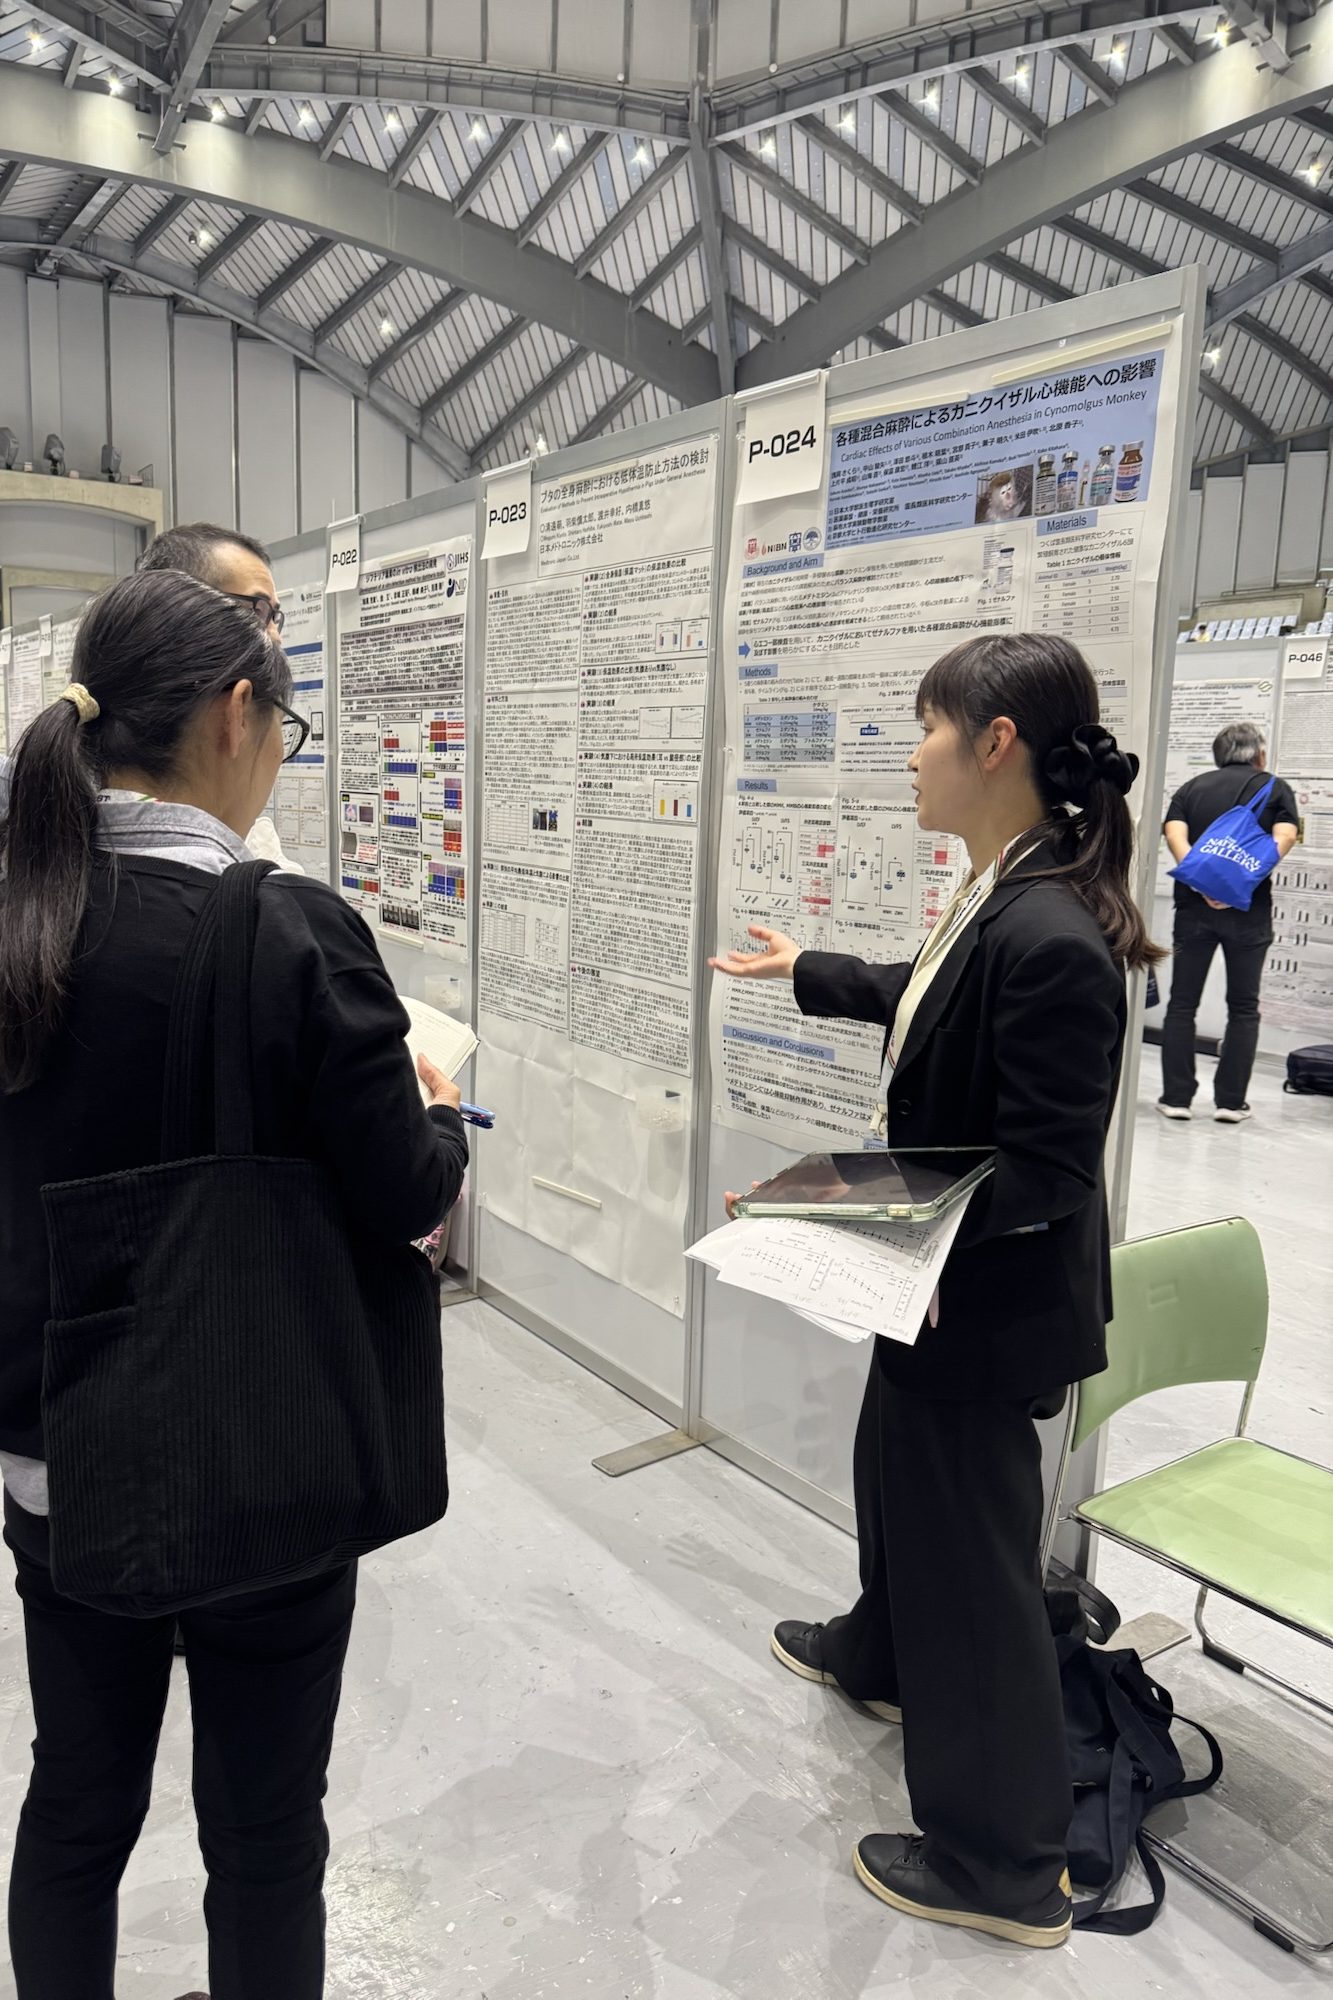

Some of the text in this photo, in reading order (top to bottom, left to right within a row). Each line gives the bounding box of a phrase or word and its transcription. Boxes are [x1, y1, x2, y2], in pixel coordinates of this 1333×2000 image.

[836, 358, 1157, 447] 各種混合麻酔によるカニクイザル心機能への影響
[841, 389, 1147, 462] Cardiac Effects of Various Combination Anesthesia in Cynomolgus Monkey
[749, 425, 816, 464] P-024
[541, 448, 709, 503] ブタの全身麻酔における低体温防止方法の検討
[489, 502, 527, 527] P-023
[1046, 516, 1087, 532] Materials
[332, 549, 357, 568] P-022
[454, 552, 469, 567] JIHS
[747, 557, 818, 576] Background and Aim
[1288, 652, 1323, 663] P-046
[745, 668, 771, 677] Methods
[744, 781, 769, 790] Results
[1200, 844, 1260, 872] GALLERY
[1206, 838, 1261, 868] NATIONAL
[732, 1028, 824, 1057] Discussion and Conclusions
